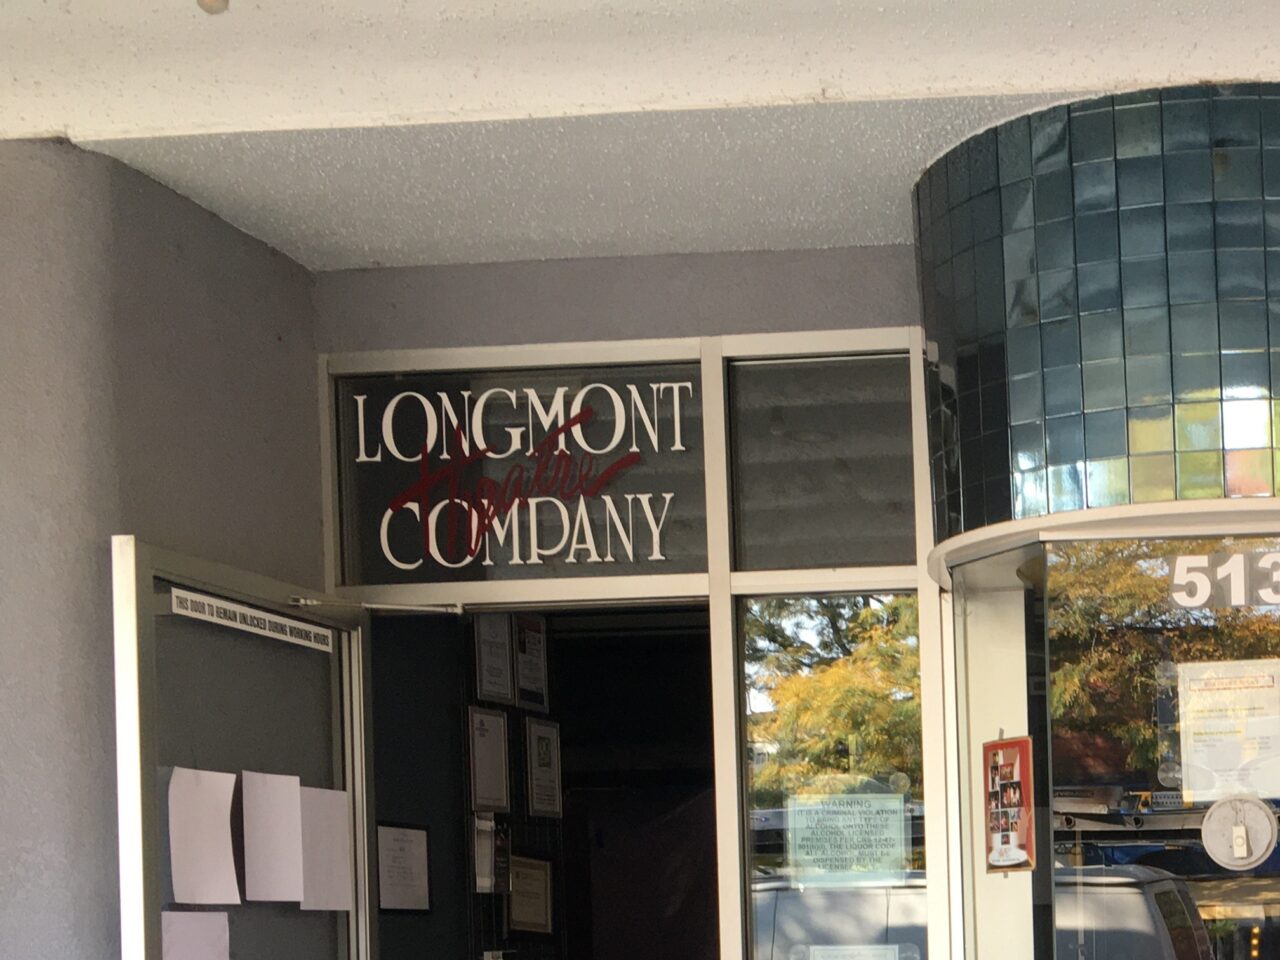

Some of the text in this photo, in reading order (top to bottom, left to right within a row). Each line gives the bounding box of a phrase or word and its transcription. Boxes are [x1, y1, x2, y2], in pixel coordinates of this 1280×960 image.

[353, 381, 693, 463] LONGMONT
[380, 492, 674, 570] COMPANY
[175, 595, 329, 646] THIS DOOR TO REMAIN UNLOCKED DURING WORKING HOURS
[820, 800, 872, 808] WARNING
[857, 808, 898, 816] VIOLATION
